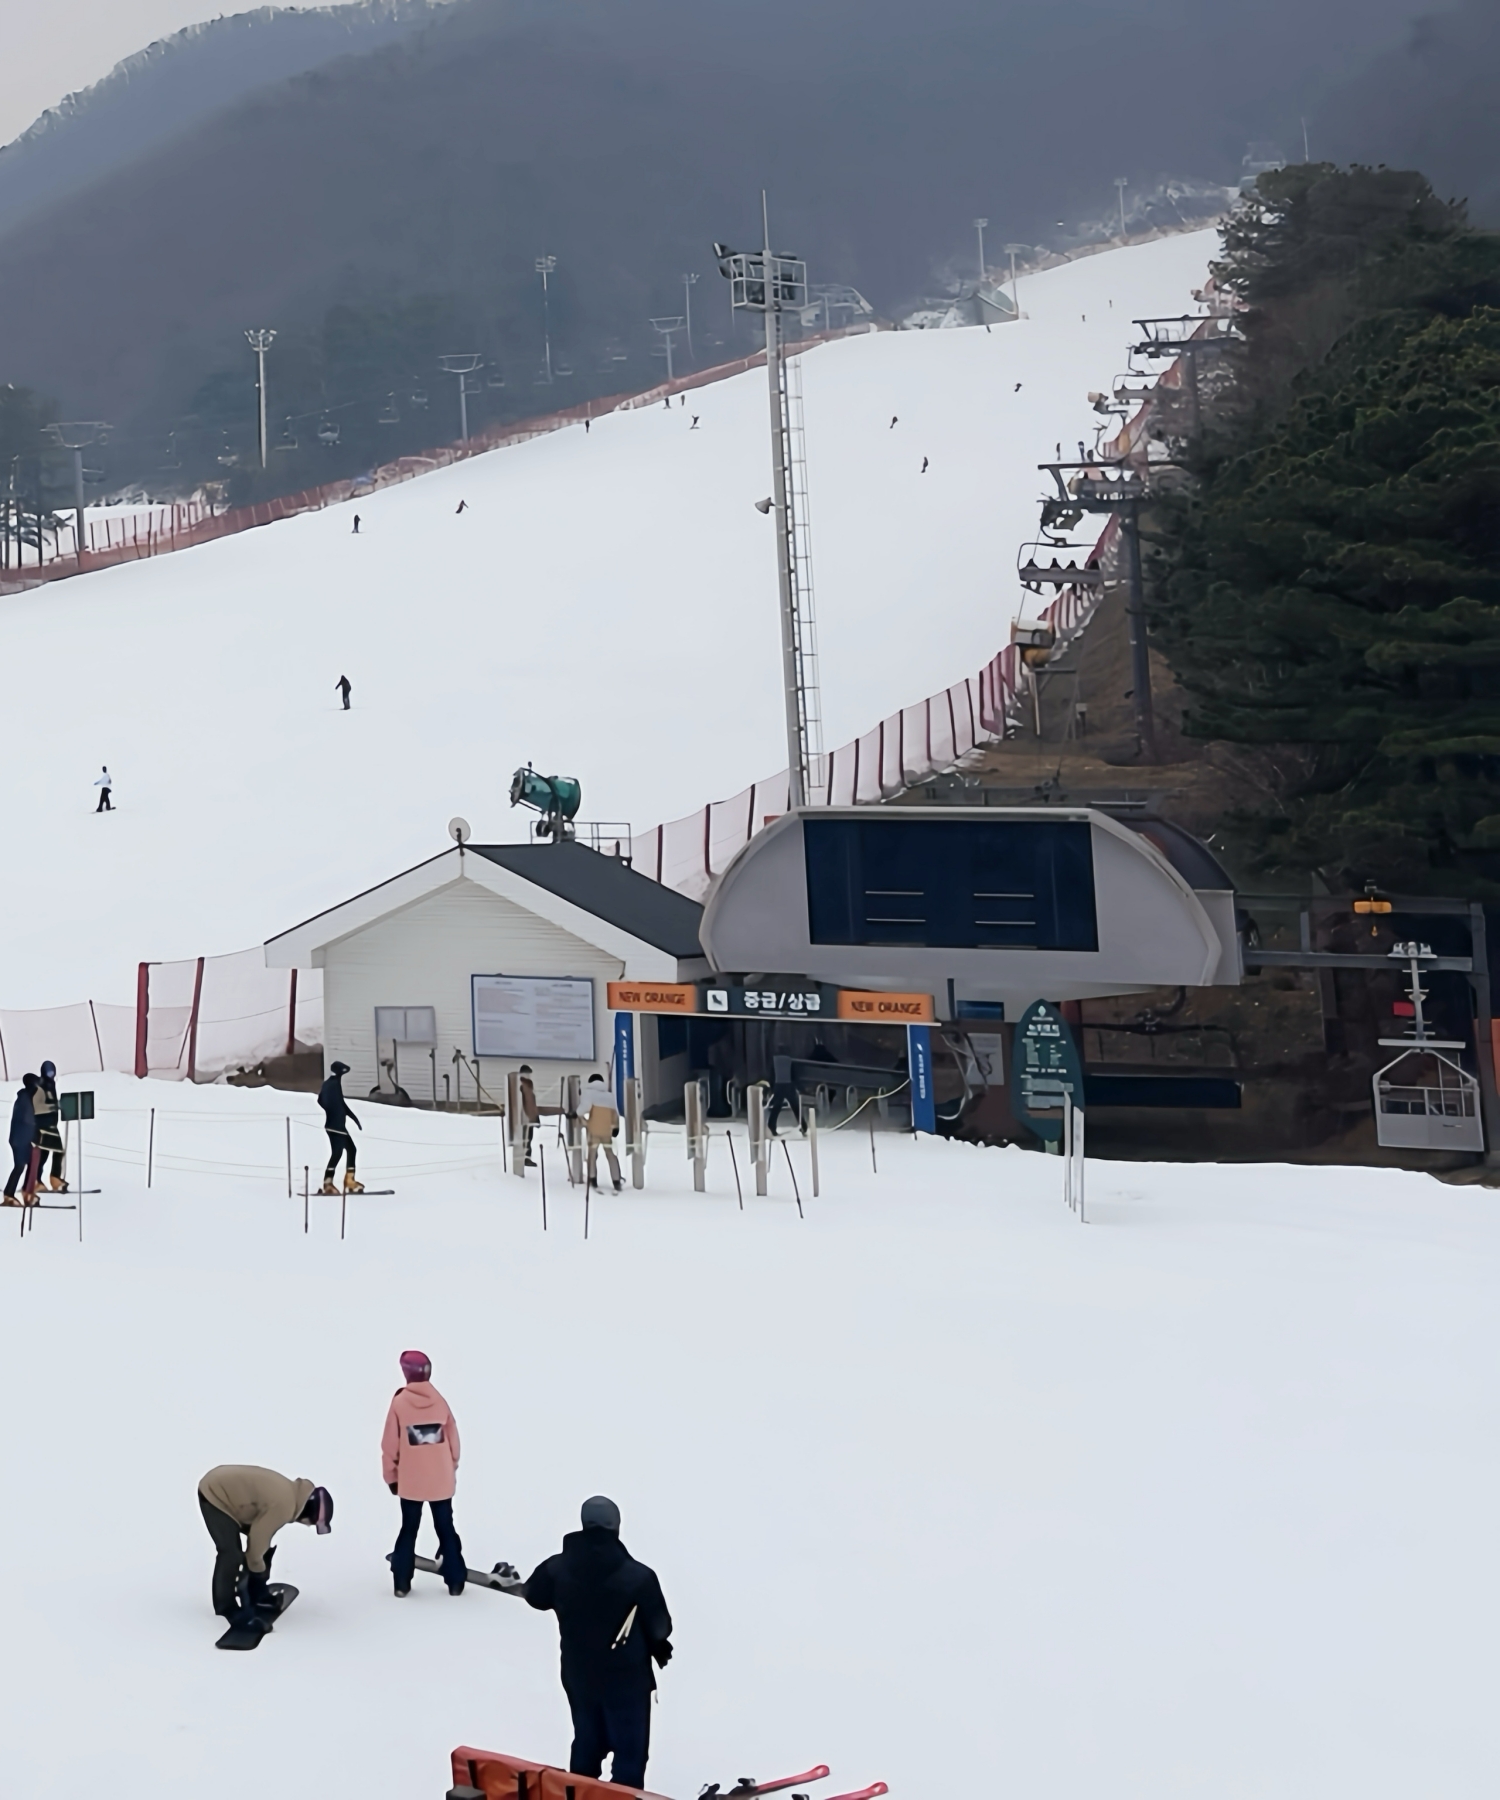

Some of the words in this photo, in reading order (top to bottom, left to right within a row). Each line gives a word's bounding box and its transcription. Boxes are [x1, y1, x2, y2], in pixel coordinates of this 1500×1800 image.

[618, 991, 640, 1004] NEW
[644, 992, 686, 1005] ORANGE
[878, 1001, 922, 1016] ORANGE
